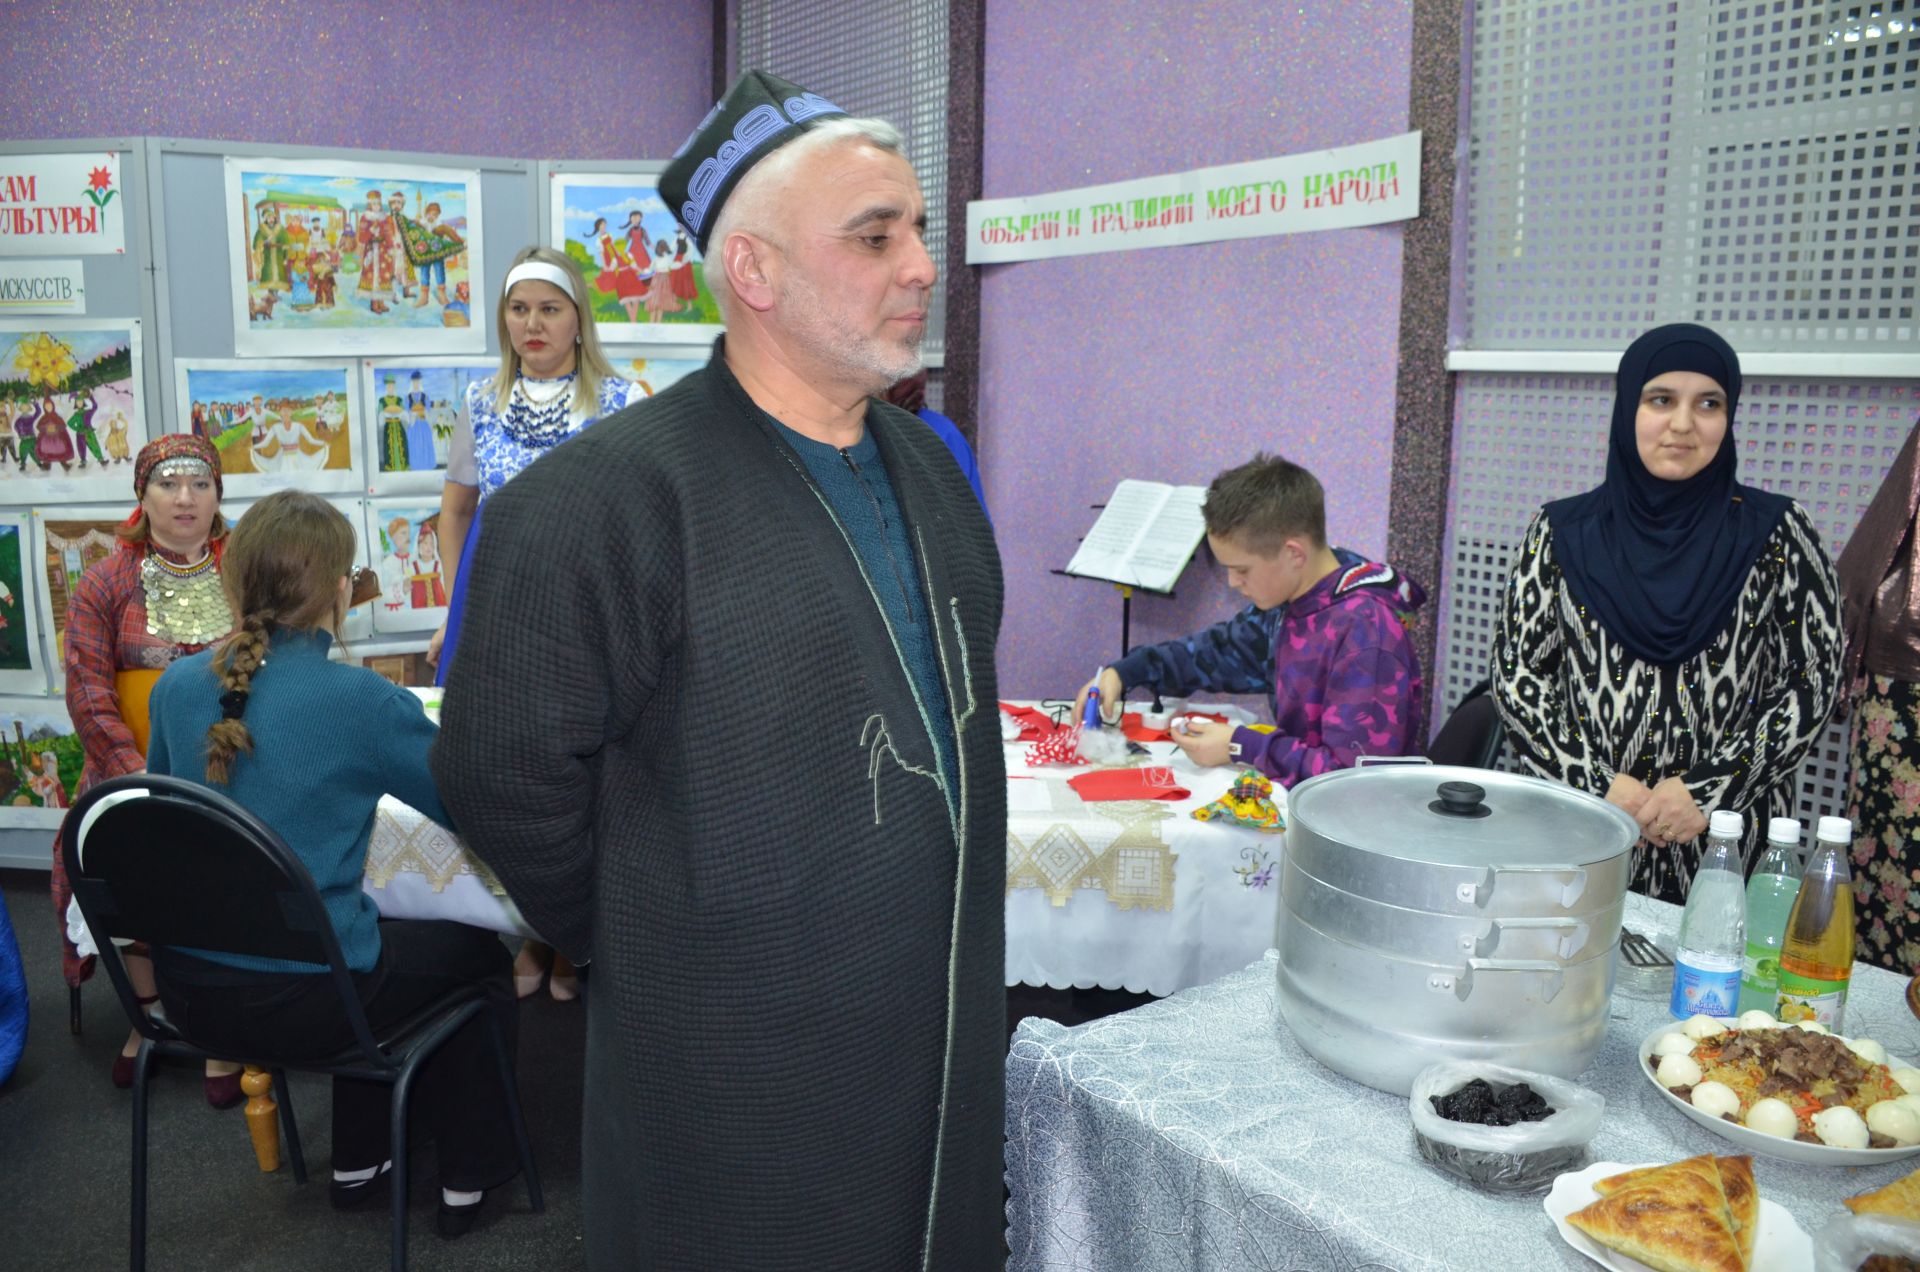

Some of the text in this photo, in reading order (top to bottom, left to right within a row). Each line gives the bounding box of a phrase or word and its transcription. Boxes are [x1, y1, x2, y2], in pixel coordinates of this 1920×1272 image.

[1066, 207, 1081, 238] И
[1089, 192, 1194, 234] ТРАДИЦИИ
[1206, 179, 1288, 221] МОЕГО
[1303, 161, 1400, 210] НАРОДА
